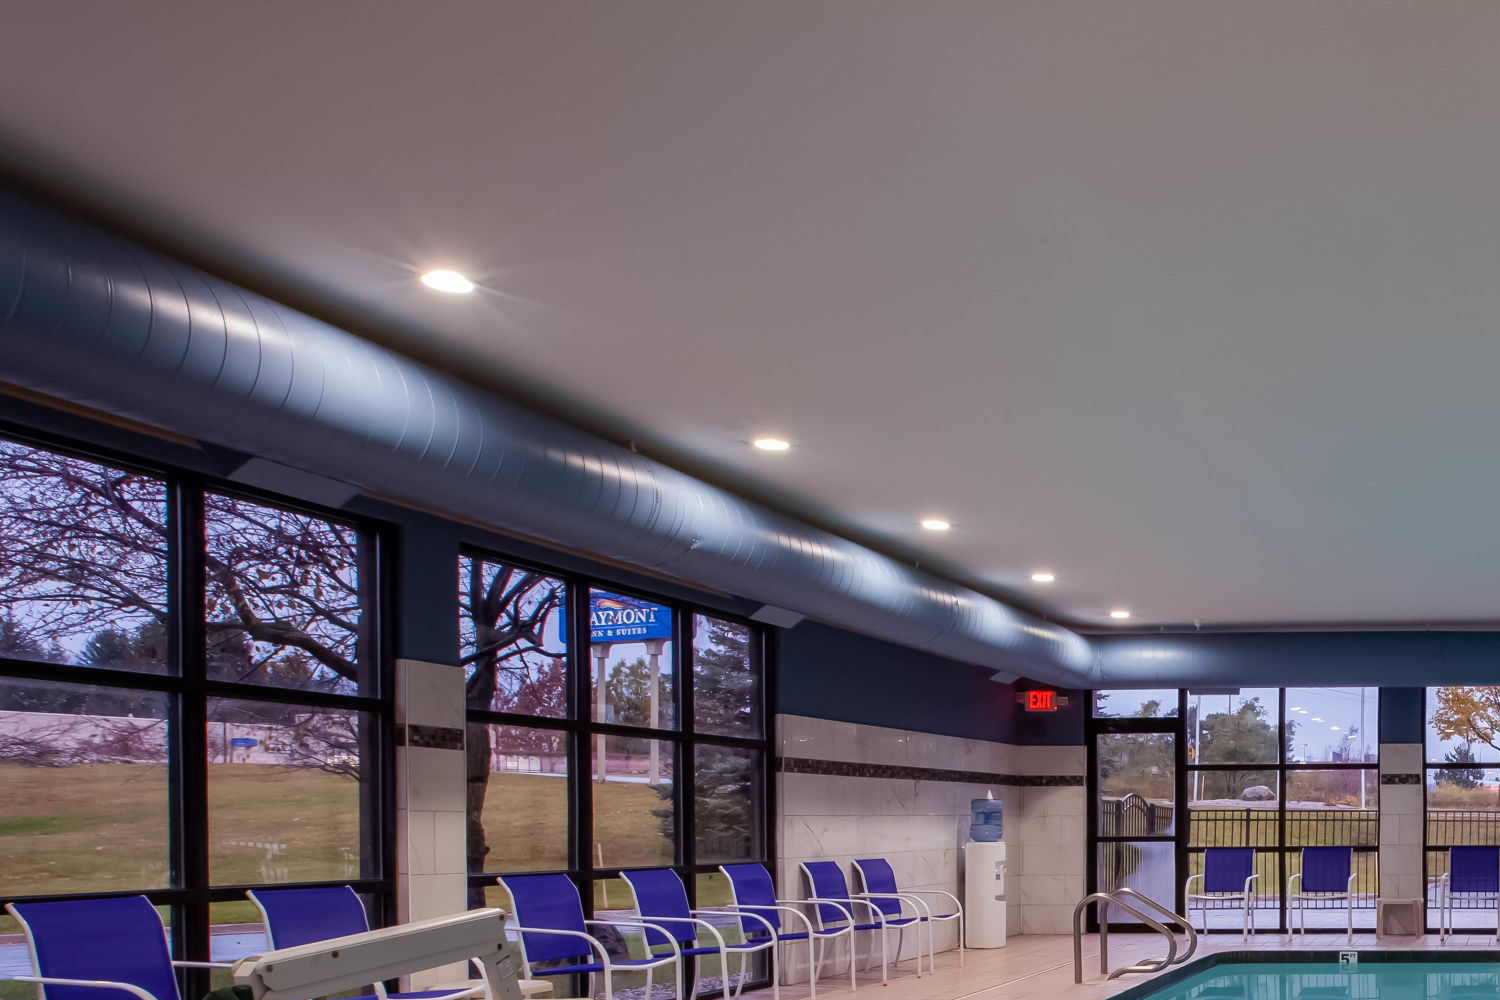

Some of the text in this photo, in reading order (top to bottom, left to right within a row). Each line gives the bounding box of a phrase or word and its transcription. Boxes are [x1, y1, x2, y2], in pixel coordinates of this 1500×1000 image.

[591, 607, 658, 626] AYMONT
[616, 627, 647, 636] SUITES
[1029, 691, 1053, 709] EXIT
